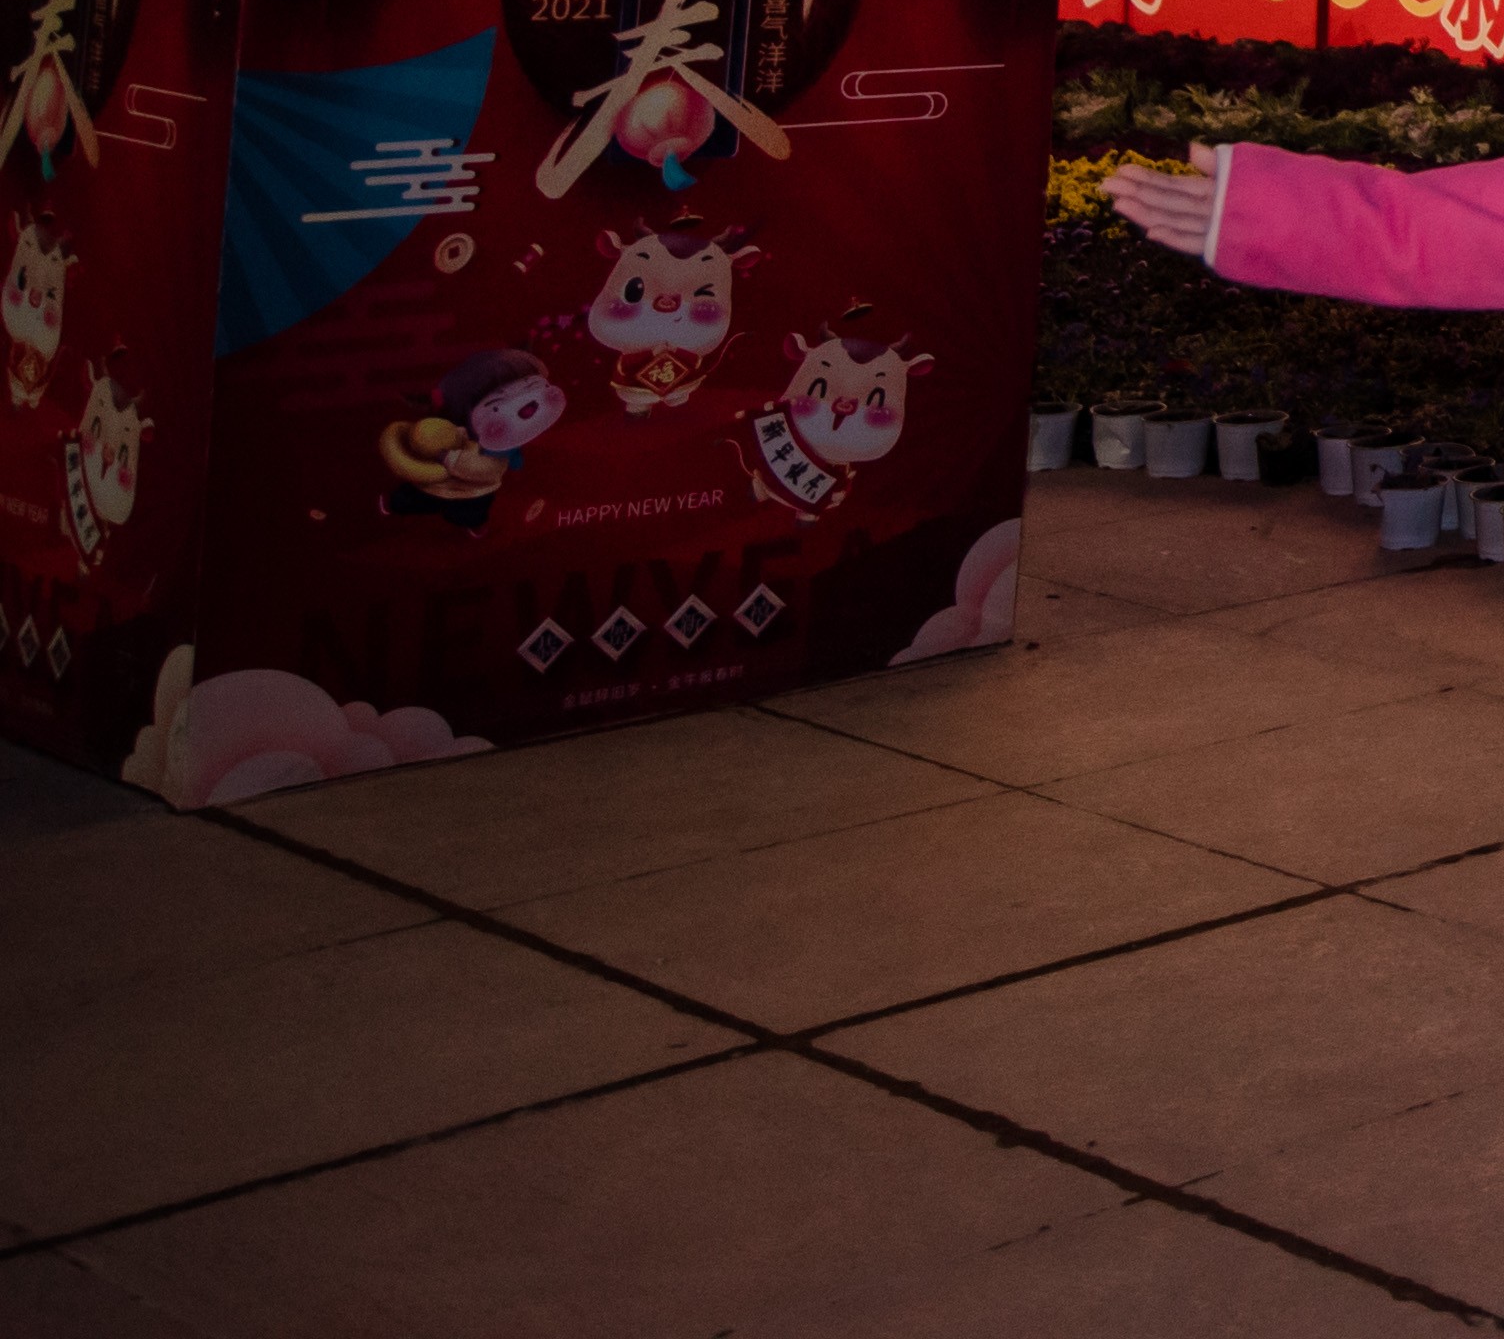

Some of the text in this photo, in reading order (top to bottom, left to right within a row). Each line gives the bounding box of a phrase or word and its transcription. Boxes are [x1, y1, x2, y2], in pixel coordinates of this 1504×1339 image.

[557, 488, 725, 527] HAPPY NEW YEAR
